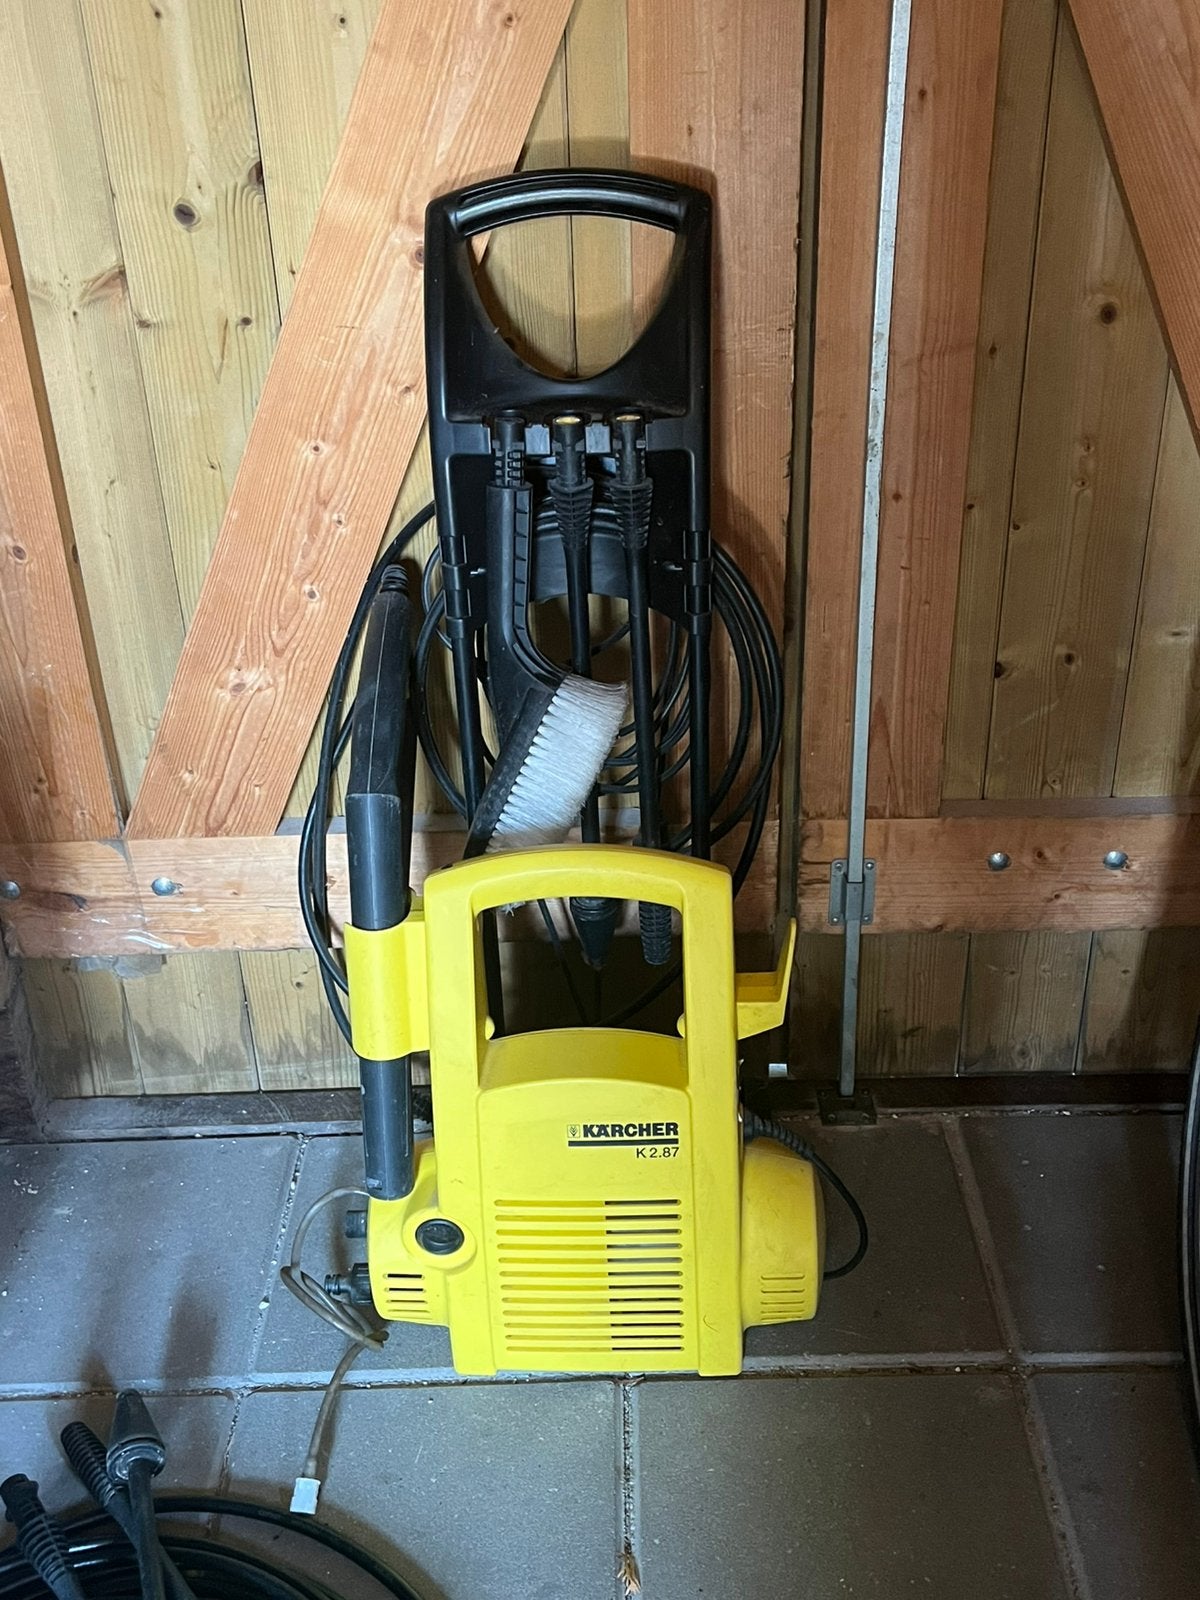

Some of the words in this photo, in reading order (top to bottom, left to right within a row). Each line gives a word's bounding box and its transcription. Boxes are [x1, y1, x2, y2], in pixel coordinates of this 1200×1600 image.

[583, 1122, 679, 1138] KÄRCHER
[636, 1147, 647, 1158] K
[649, 1146, 680, 1158] 2.87
